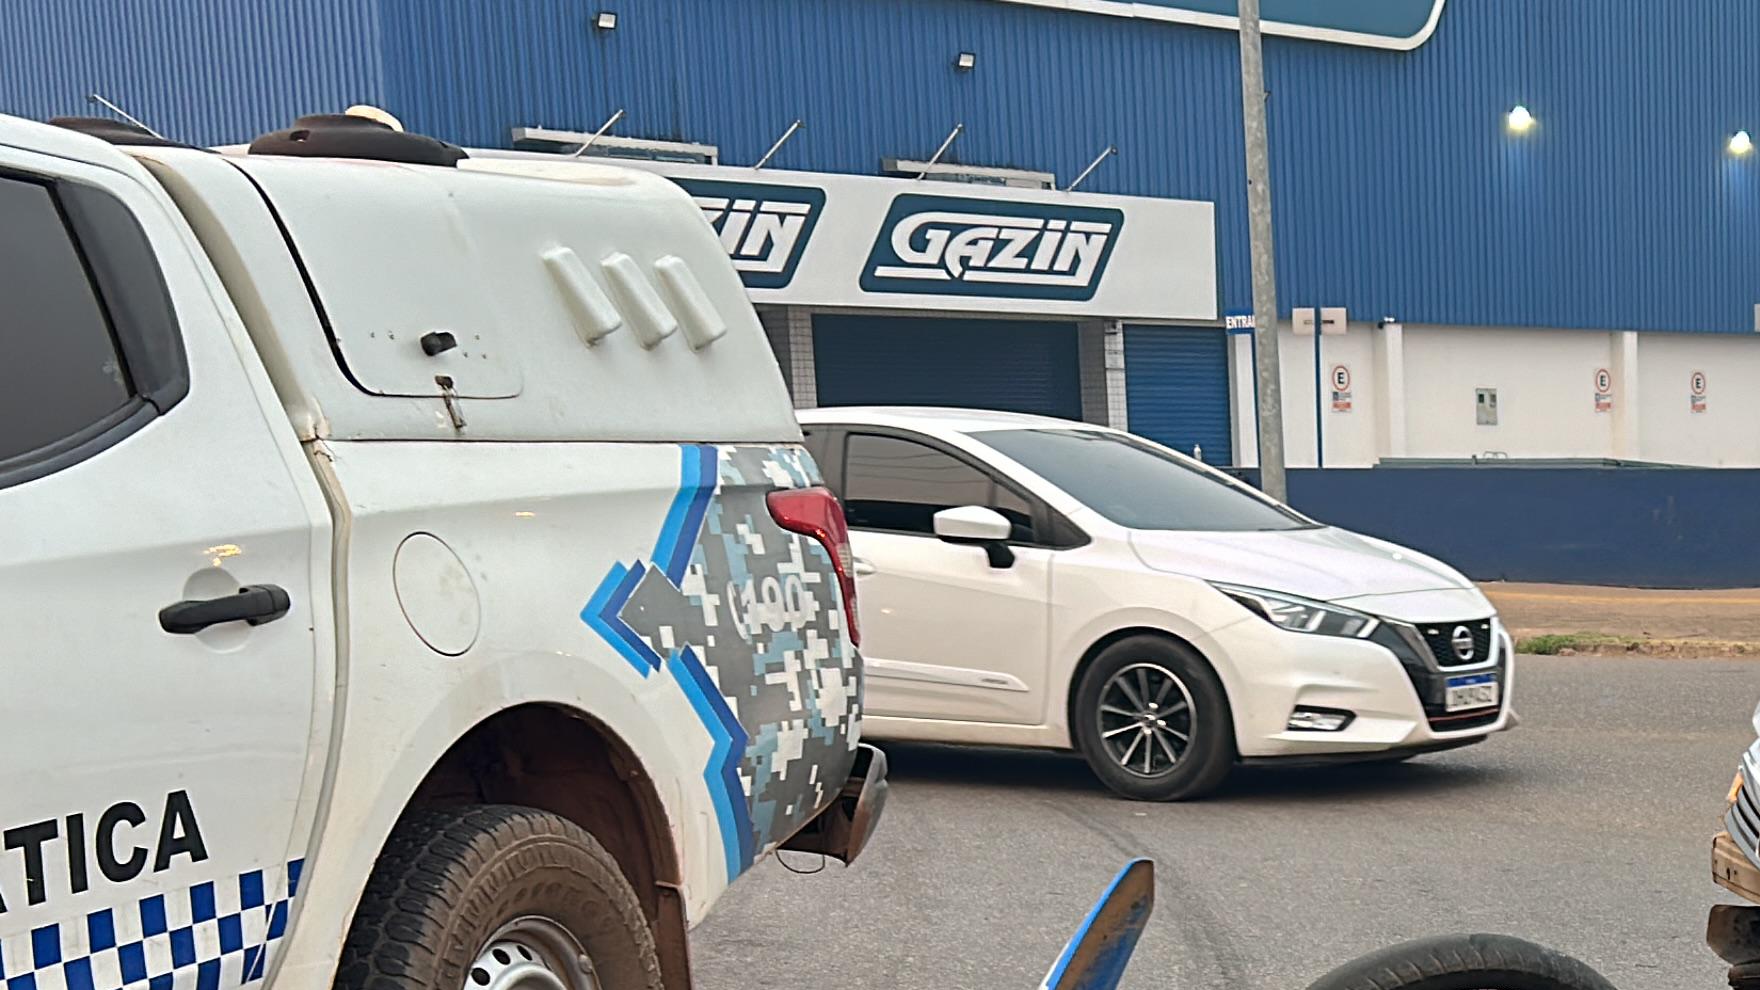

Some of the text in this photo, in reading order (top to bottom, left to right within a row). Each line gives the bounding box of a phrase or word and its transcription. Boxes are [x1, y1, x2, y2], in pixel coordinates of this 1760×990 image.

[875, 210, 1113, 287] GAZIN
[1225, 315, 1256, 329] ENTRA
[1337, 372, 1345, 384] E
[0, 789, 208, 913] TICA
